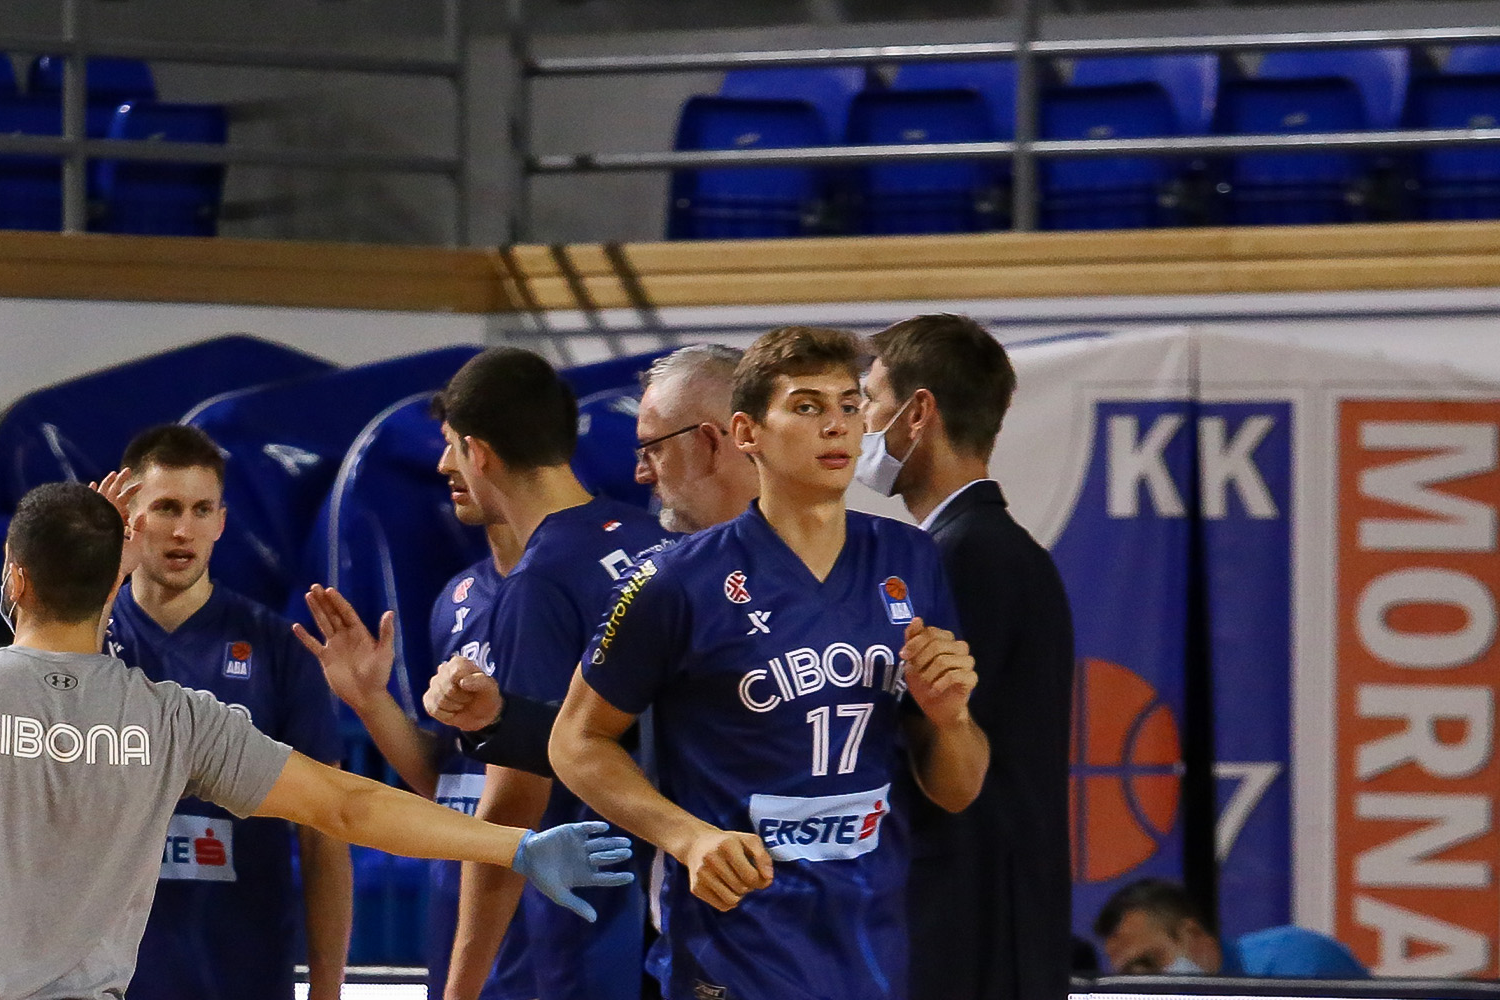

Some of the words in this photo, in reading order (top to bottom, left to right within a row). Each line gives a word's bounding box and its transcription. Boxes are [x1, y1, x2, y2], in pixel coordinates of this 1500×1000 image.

[1106, 413, 1280, 521] KK
[806, 703, 874, 777] 17
[1353, 420, 1499, 978] MORNA
[759, 815, 860, 849] ERSTE
